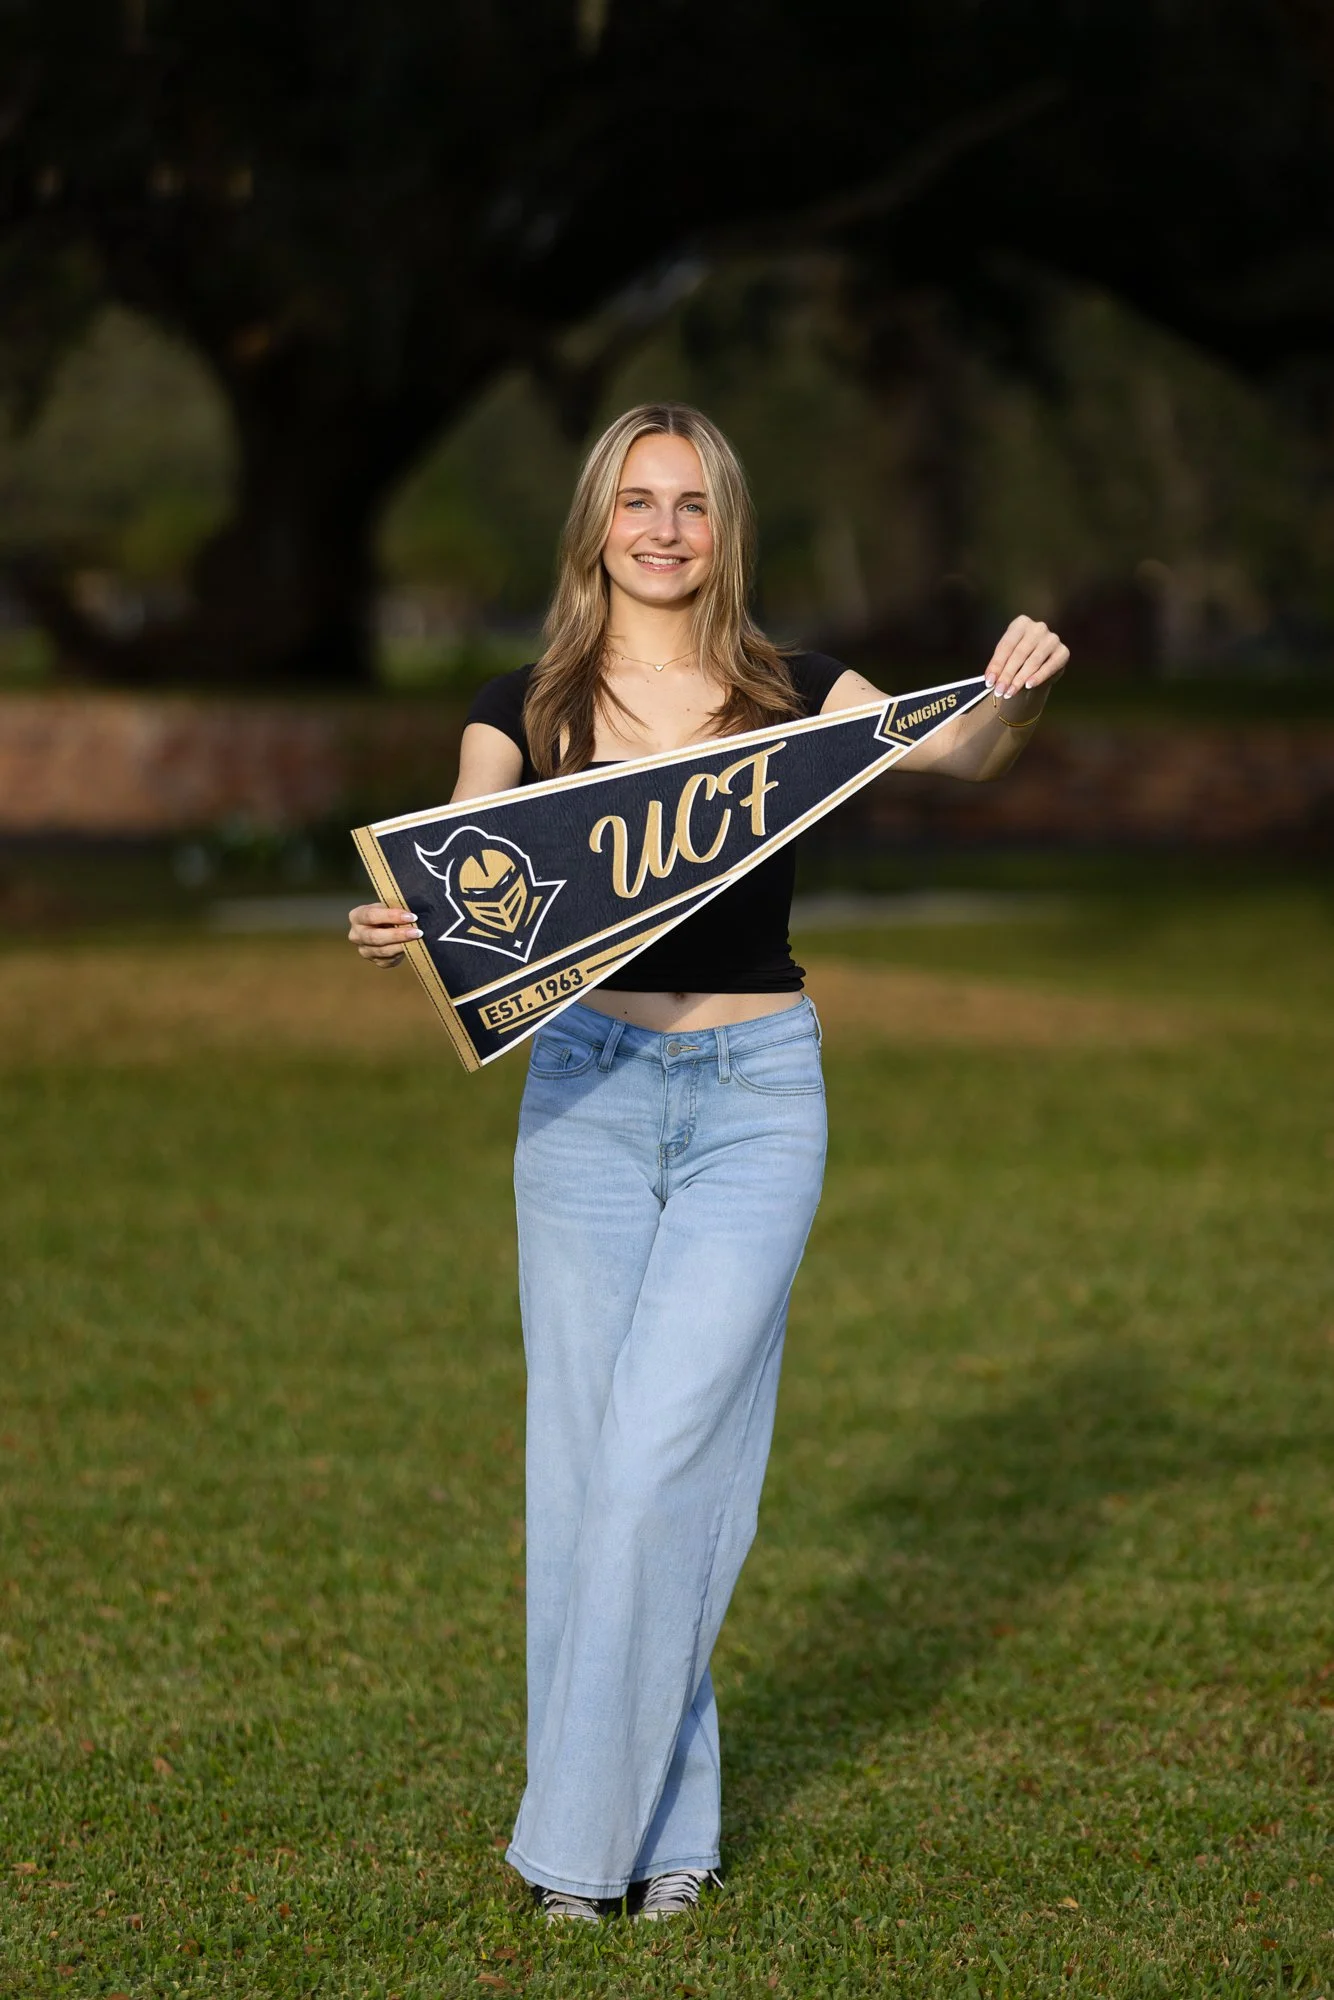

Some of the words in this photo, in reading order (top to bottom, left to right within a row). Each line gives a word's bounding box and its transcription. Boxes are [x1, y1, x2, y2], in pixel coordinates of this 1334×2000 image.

[895, 693, 957, 733] KNIGHTS
[588, 740, 787, 899] UCF
[484, 993, 533, 1026] EST.
[535, 968, 584, 1002] 1963
